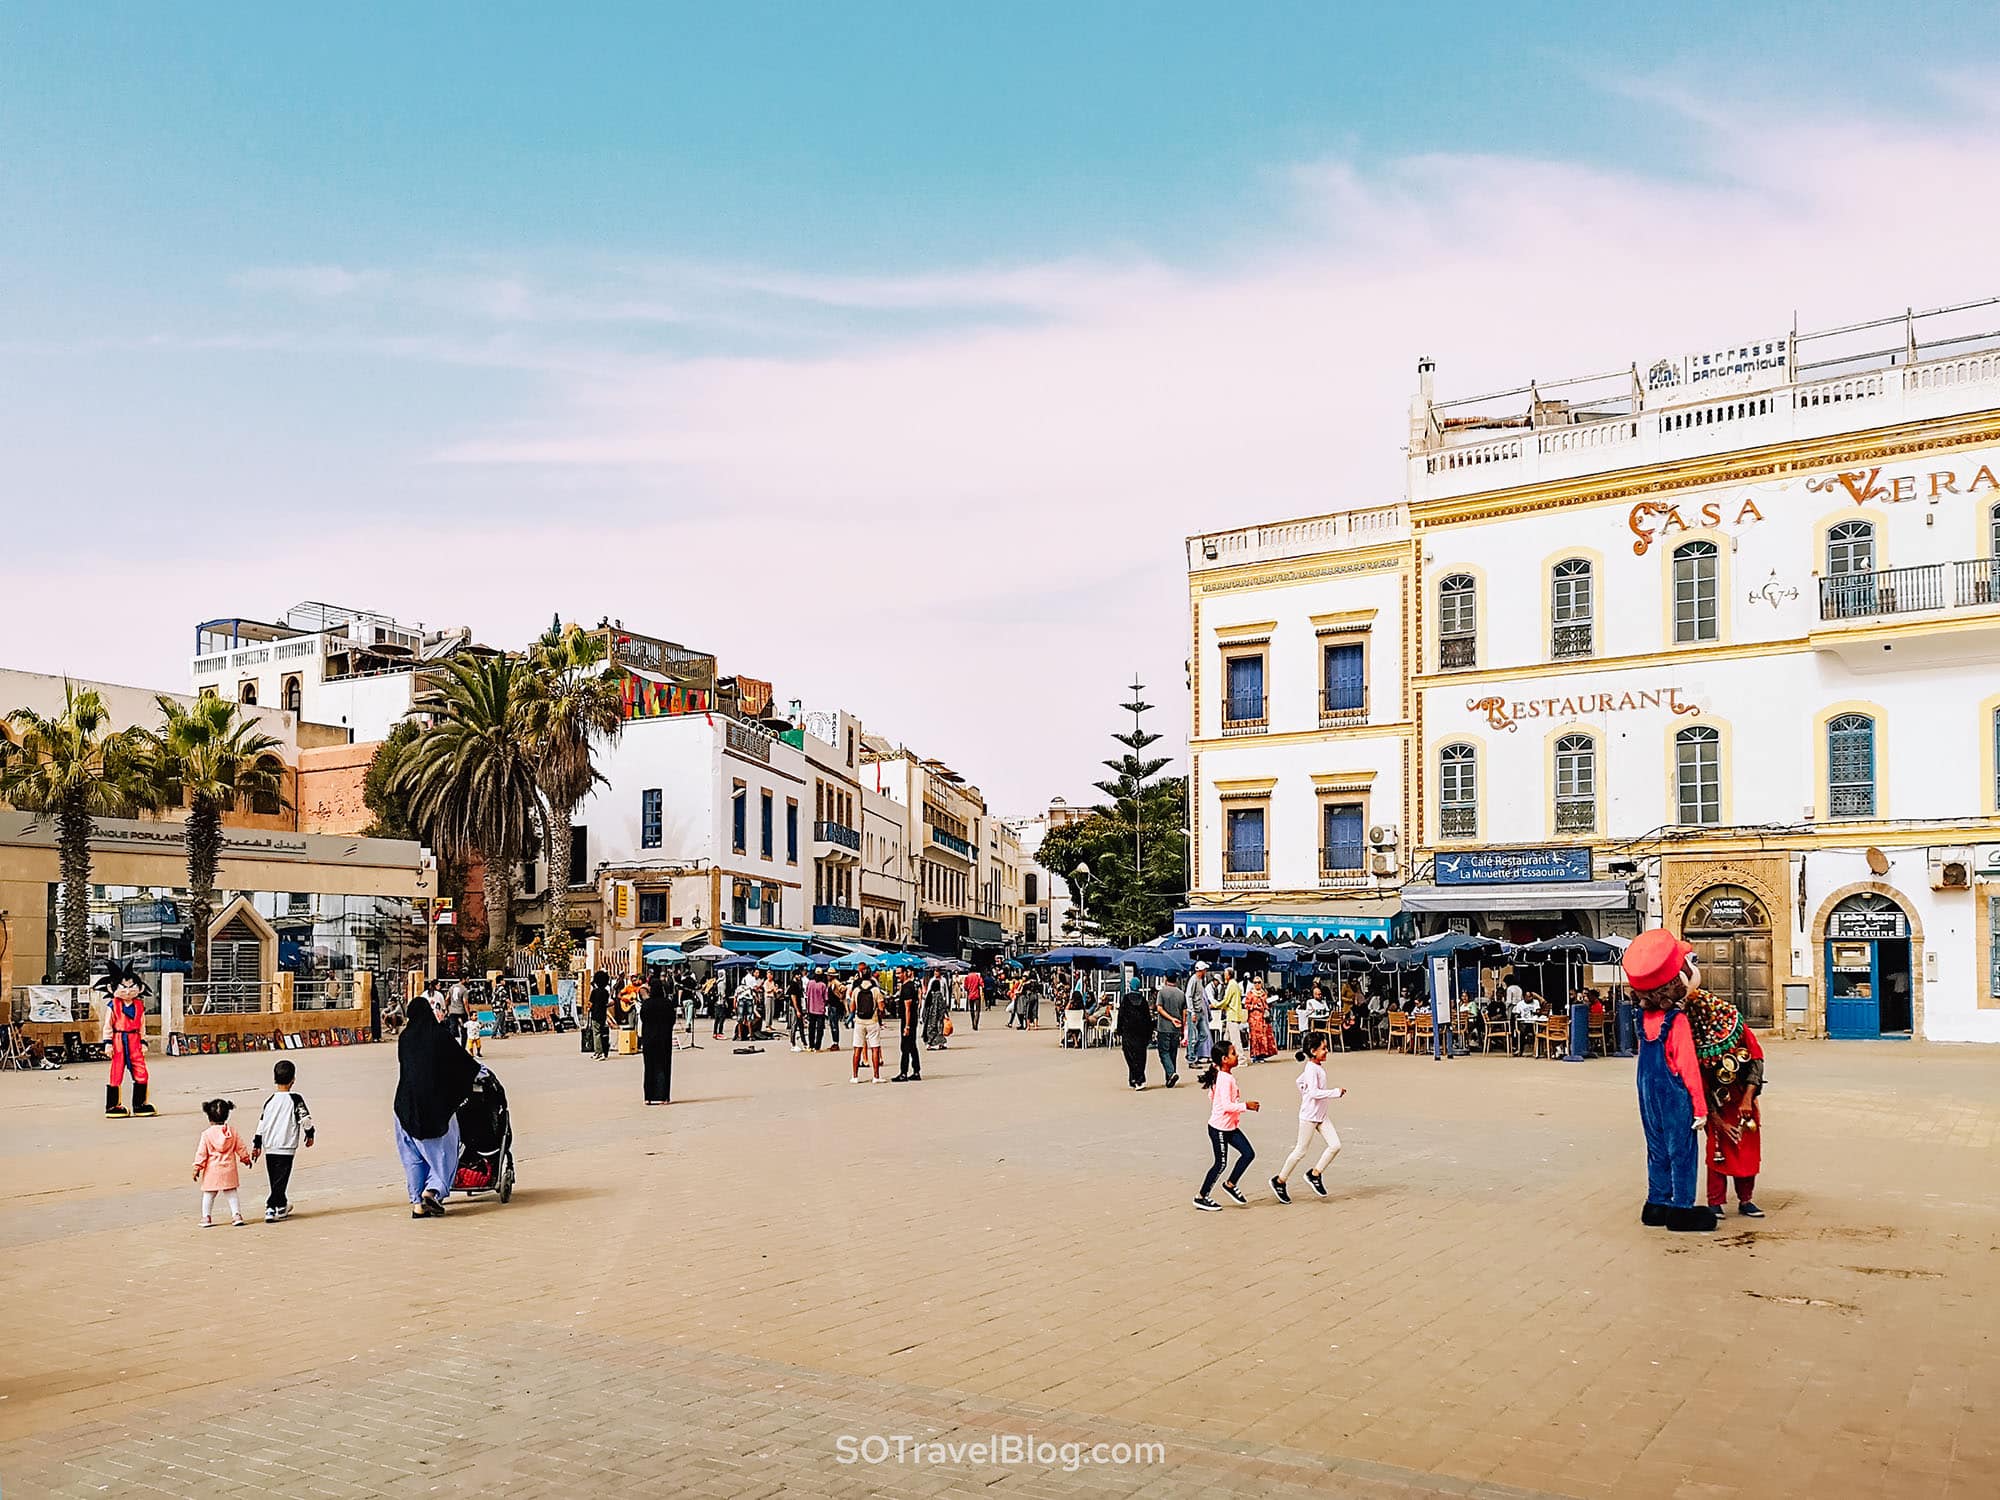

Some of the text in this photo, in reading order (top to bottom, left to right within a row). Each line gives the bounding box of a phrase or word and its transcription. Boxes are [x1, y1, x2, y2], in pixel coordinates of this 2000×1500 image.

[1466, 686, 1701, 734] RESTAURANT
[92, 829, 128, 839] ANQUE
[1470, 854, 1550, 868] Café Restaurant
[1460, 866, 1566, 879] La Mouette d'Essaouira
